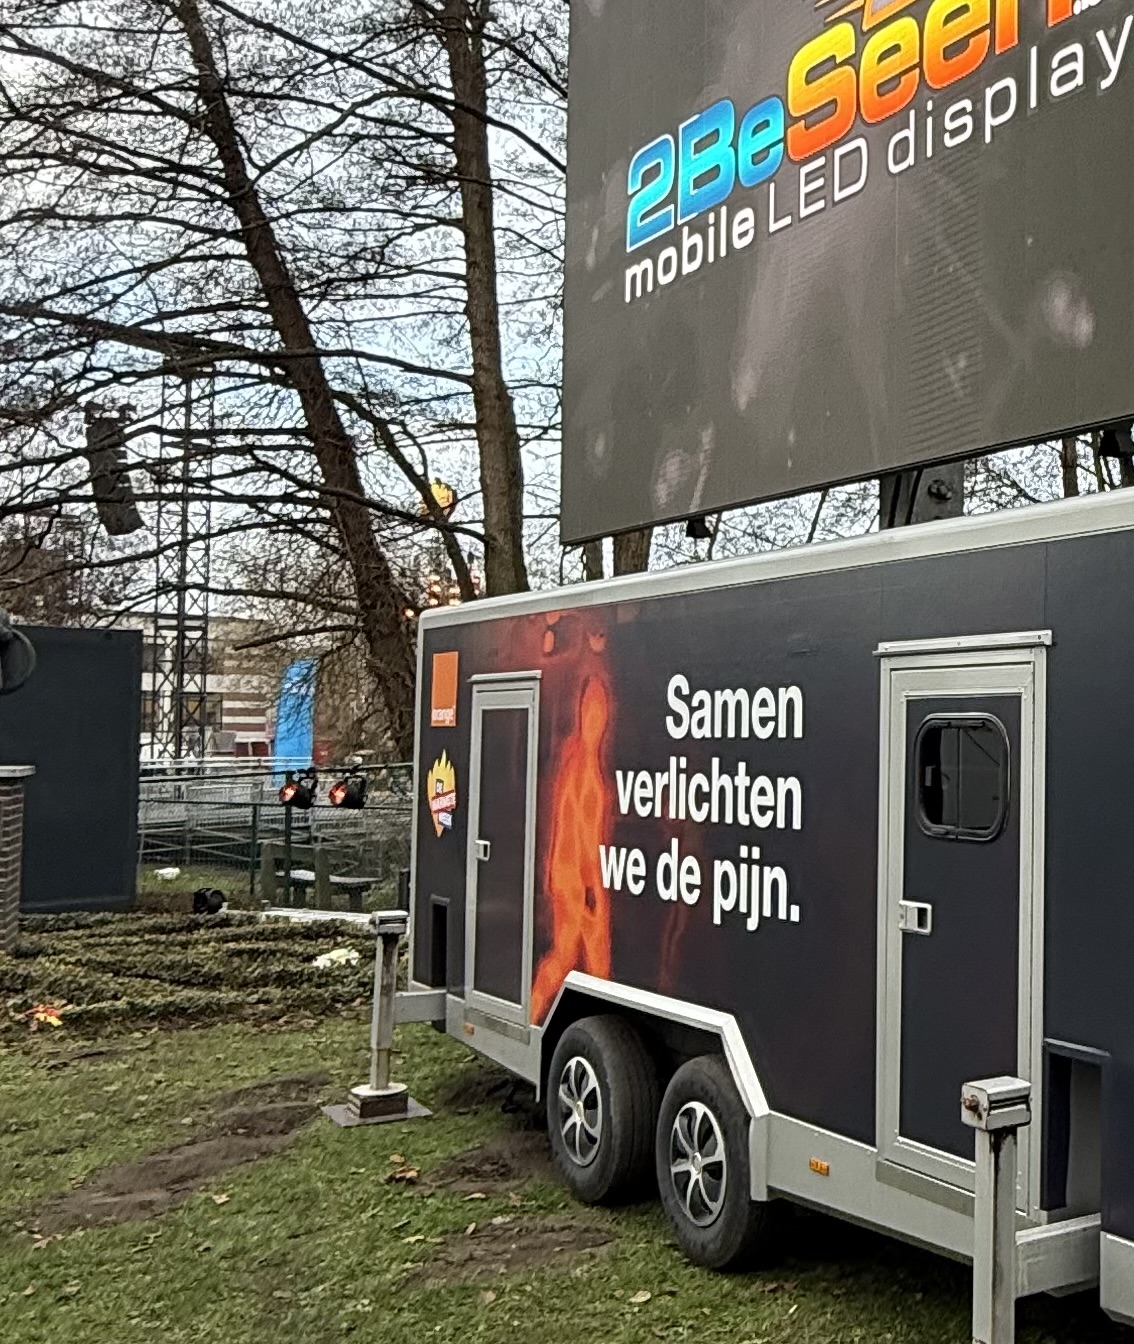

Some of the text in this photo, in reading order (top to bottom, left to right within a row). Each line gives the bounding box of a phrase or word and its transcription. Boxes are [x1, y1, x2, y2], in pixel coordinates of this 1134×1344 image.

[624, 14, 1134, 304] mobile LED display
[666, 674, 803, 739] Samen
[615, 756, 802, 831] verlichten
[599, 837, 800, 931] we de pijn.
